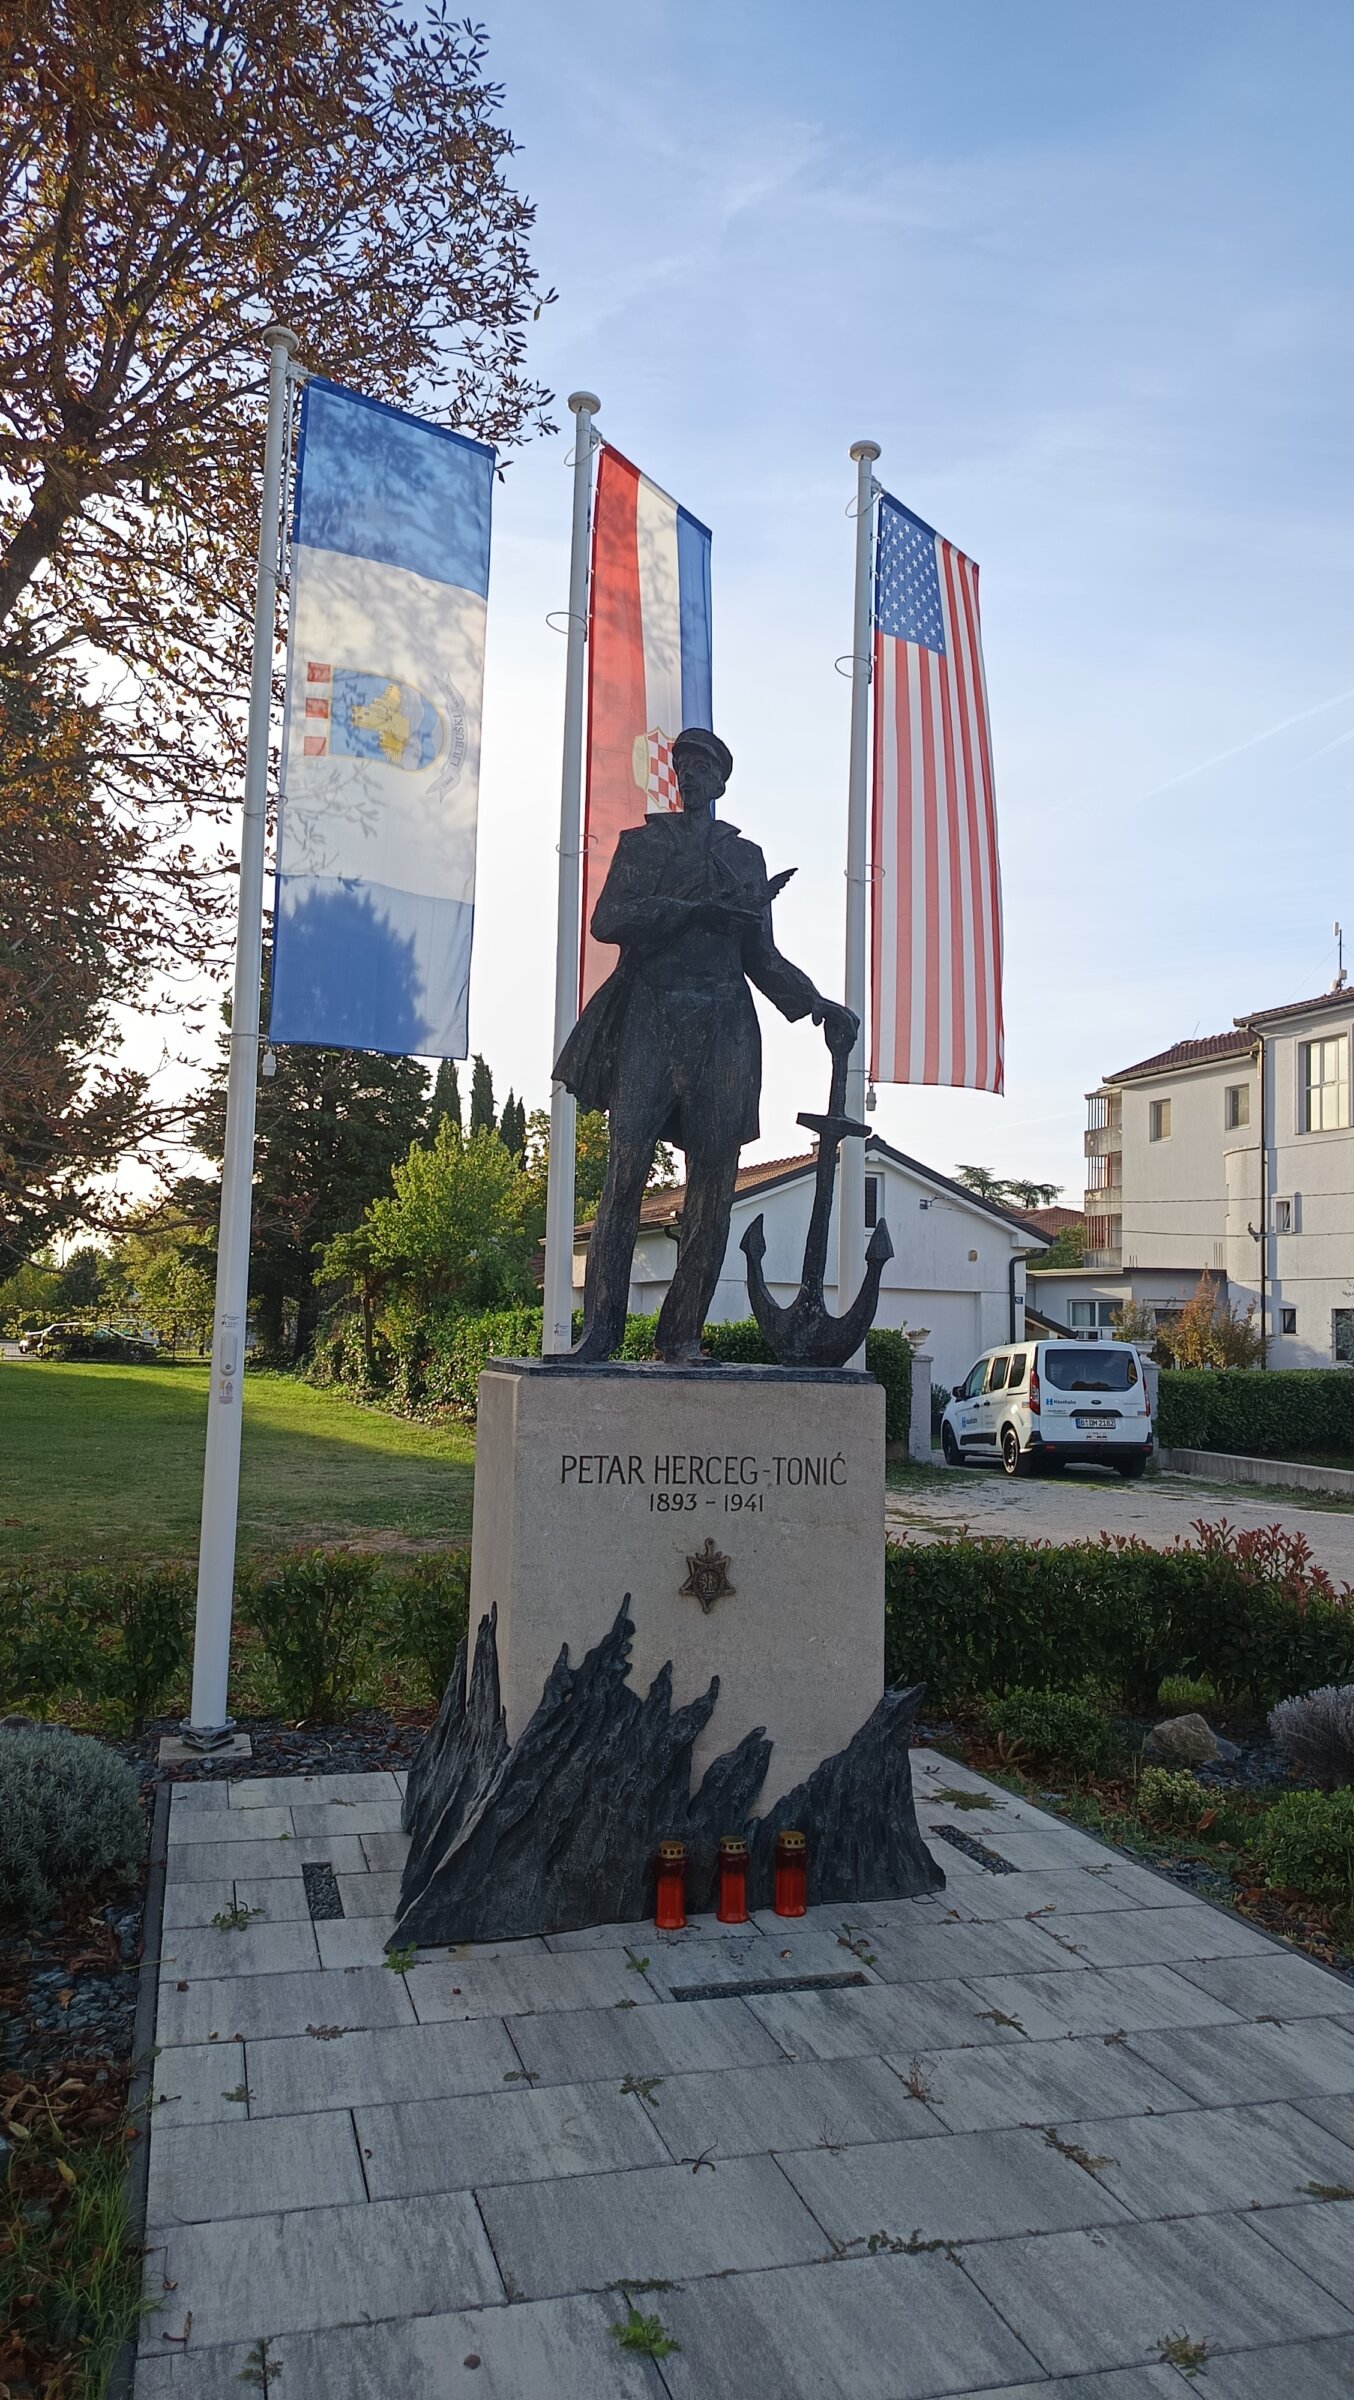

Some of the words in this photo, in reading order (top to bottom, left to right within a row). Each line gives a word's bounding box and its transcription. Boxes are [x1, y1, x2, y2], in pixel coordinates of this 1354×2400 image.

[450, 714, 465, 768] LJUBUŠKI
[561, 1455, 645, 1485] PETAR
[654, 1452, 847, 1486] HERCEG-TONIĆ
[650, 1493, 698, 1512] 1893
[724, 1493, 763, 1512] 1941
